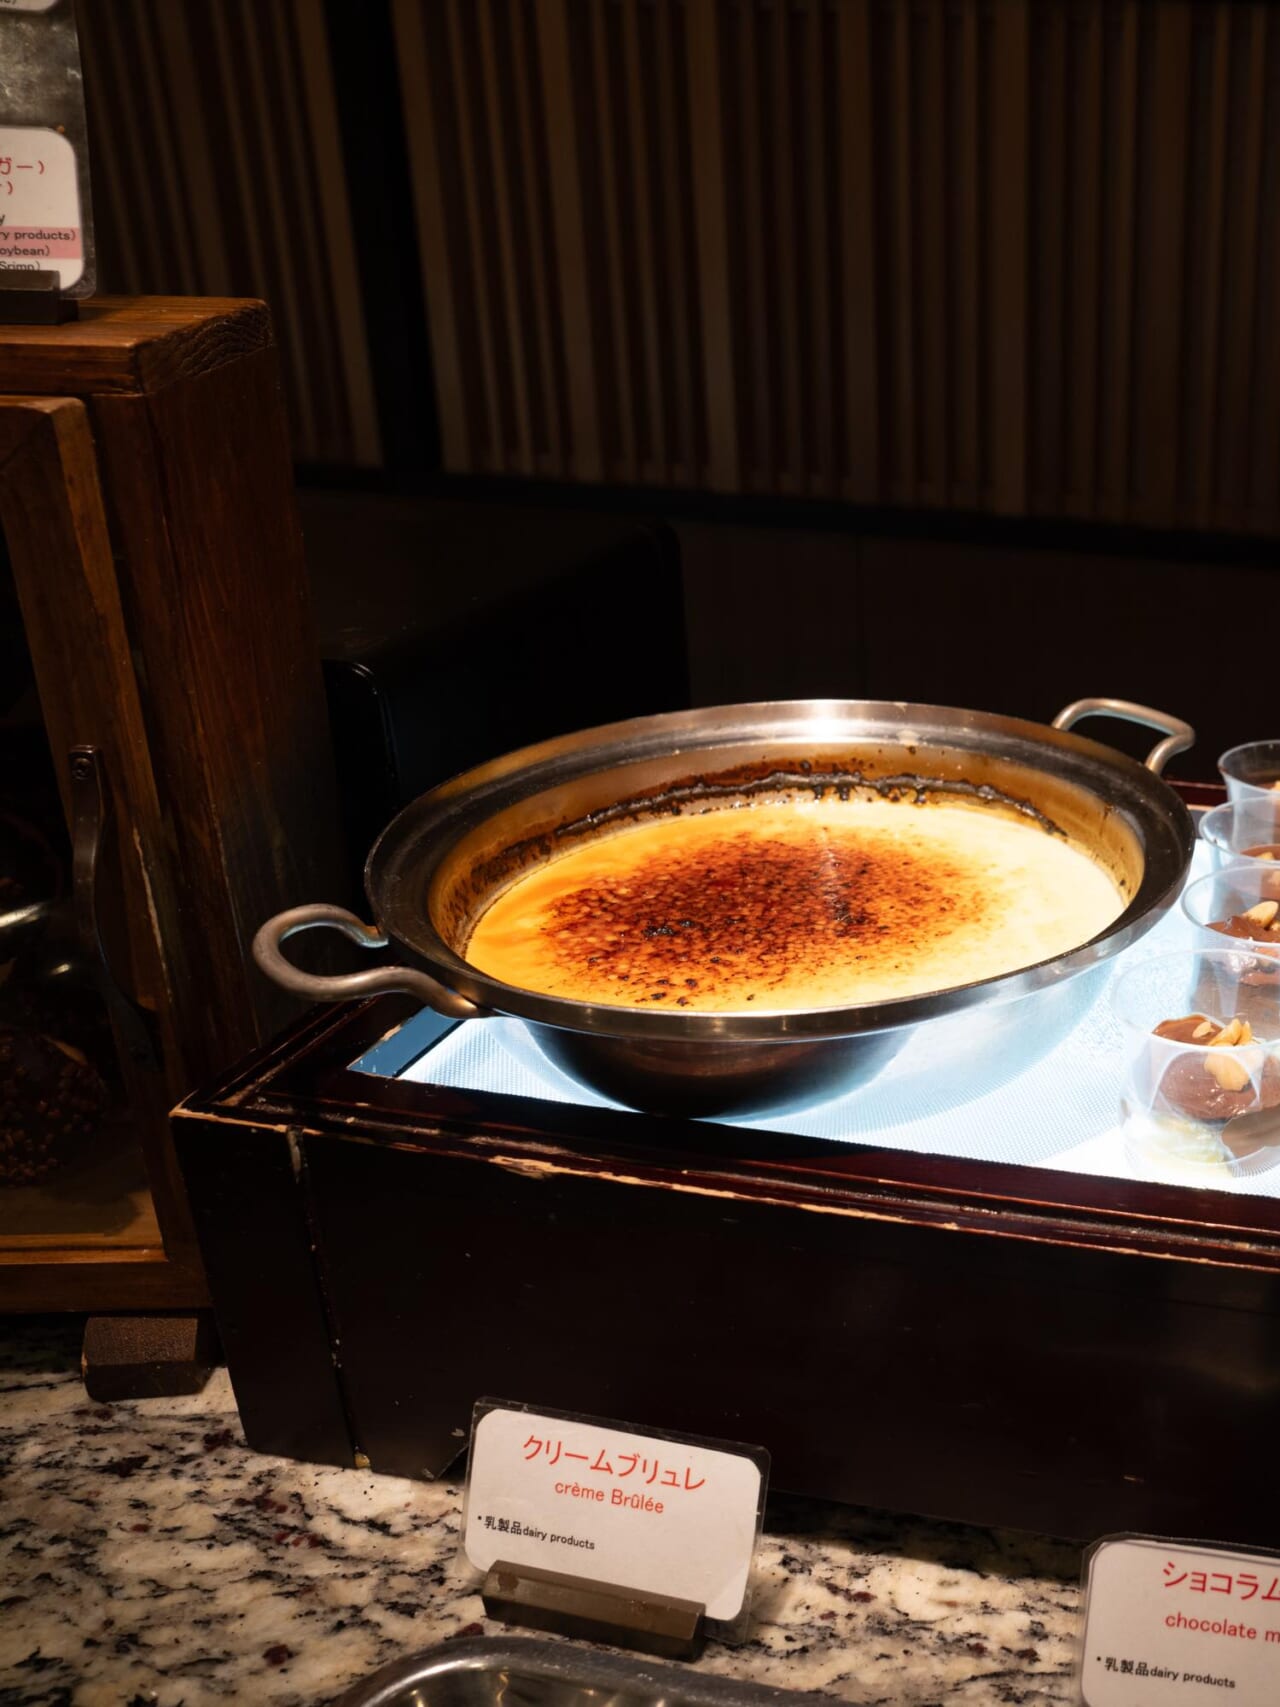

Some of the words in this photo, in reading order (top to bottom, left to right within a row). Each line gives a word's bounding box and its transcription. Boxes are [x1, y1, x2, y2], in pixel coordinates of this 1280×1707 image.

[14, 228, 76, 241] products)
[523, 1434, 706, 1491] クリームブリュレ
[554, 1481, 606, 1502] crème
[611, 1488, 665, 1514] Brûlée
[550, 1532, 596, 1551] products
[1165, 1612, 1257, 1640] chocolate
[1182, 1671, 1237, 1689] products
